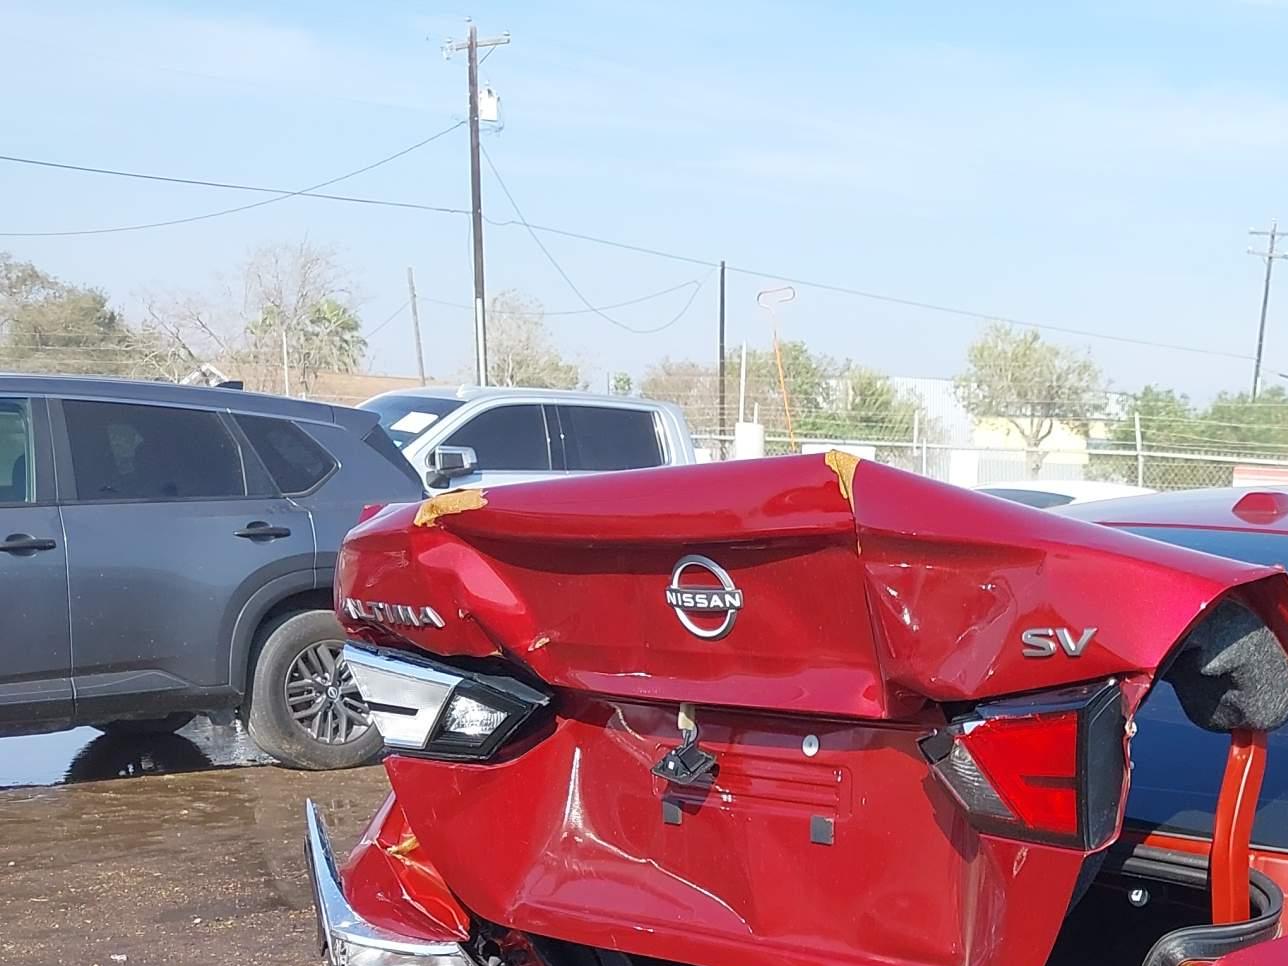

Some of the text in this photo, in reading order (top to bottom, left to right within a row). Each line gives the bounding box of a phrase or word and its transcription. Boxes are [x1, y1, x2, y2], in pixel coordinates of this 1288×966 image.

[342, 598, 446, 628] ALTIMA
[666, 591, 741, 608] NISSAN
[1022, 627, 1098, 656] SV
